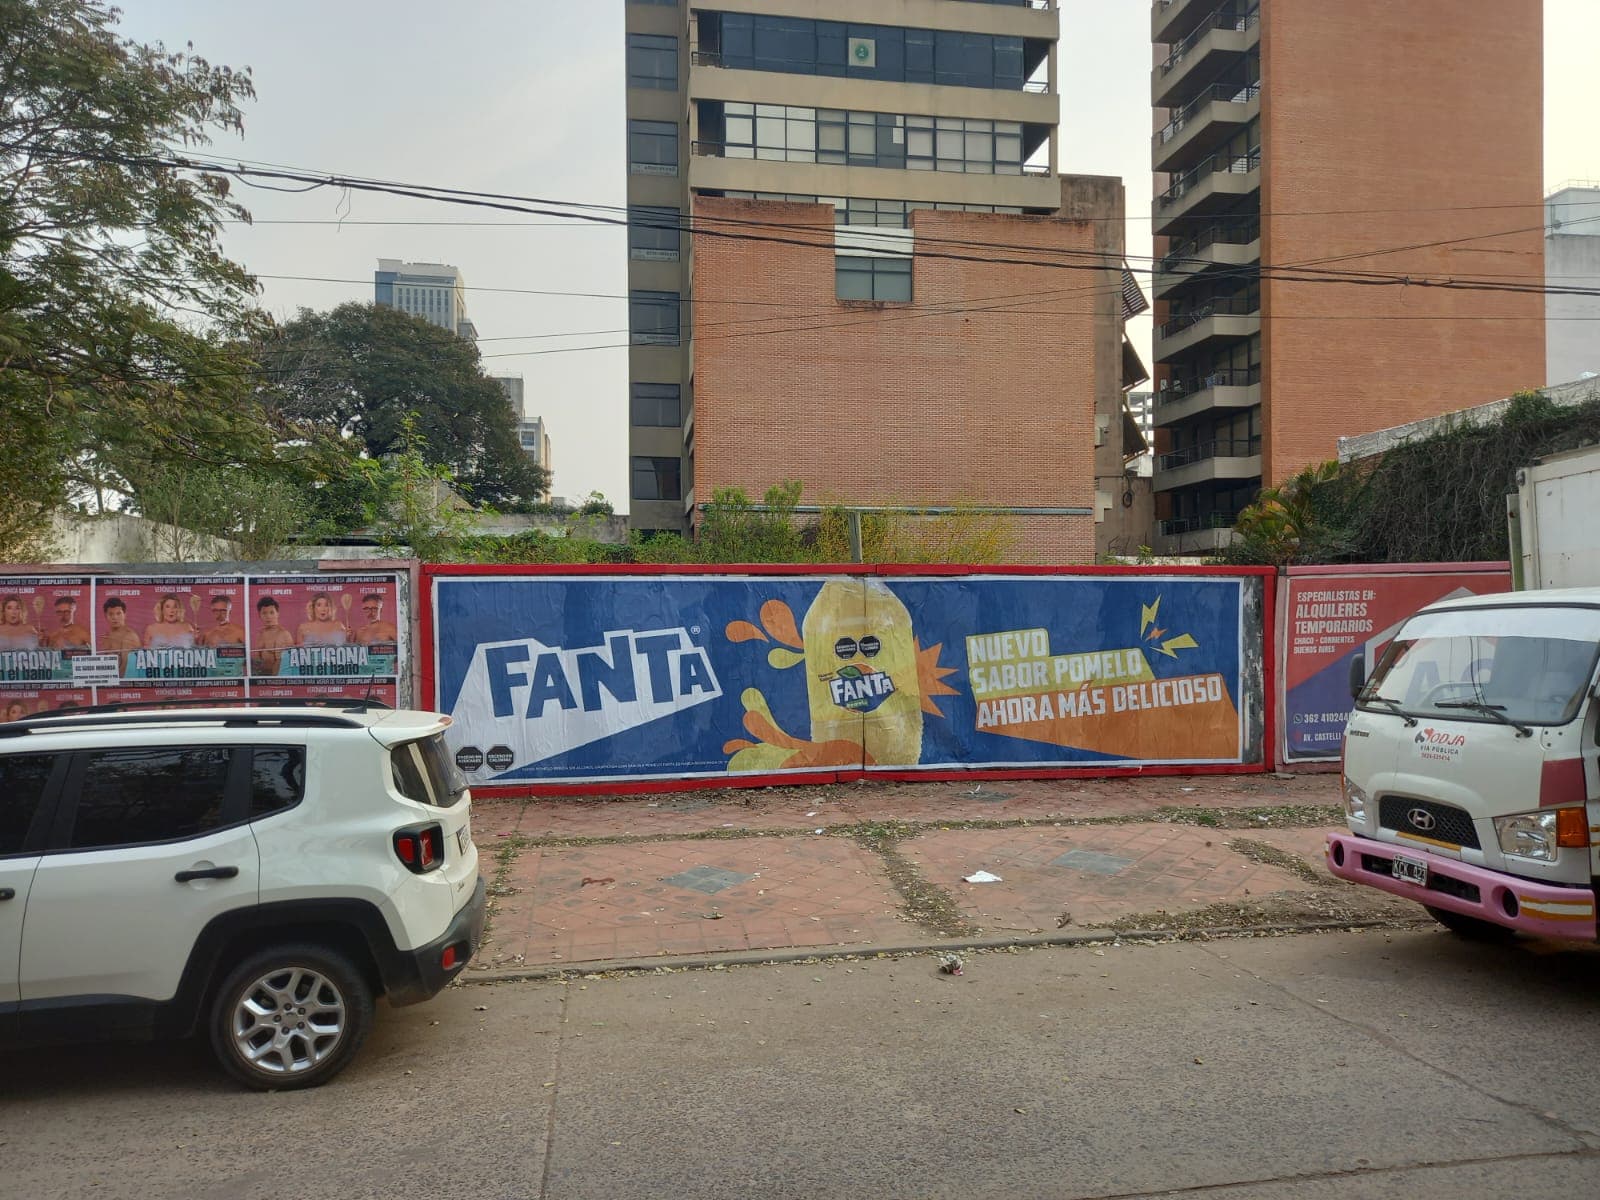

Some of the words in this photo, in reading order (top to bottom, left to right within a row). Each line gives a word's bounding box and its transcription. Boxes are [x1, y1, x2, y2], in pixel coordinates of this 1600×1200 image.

[1297, 590, 1360, 602] ESPECIALISTAS
[1296, 602, 1367, 618] ALQUILERES
[1295, 619, 1373, 635] TEMPORARIOS
[290, 646, 369, 667] ANTIGONA
[970, 628, 1048, 664] NUEVO
[0, 649, 61, 672] TIGONA
[136, 648, 217, 669] ANTIGONA
[484, 631, 714, 720] FANTA
[972, 657, 1048, 694] SABOR
[1054, 650, 1142, 684] POMELO
[830, 673, 894, 704] FANTA
[978, 694, 1054, 728] AHORA
[1058, 683, 1105, 719] MÁS
[1112, 675, 1222, 712] DELICIOSO
[1304, 713, 1319, 724] 362
[1315, 732, 1341, 742] CASTELLI
